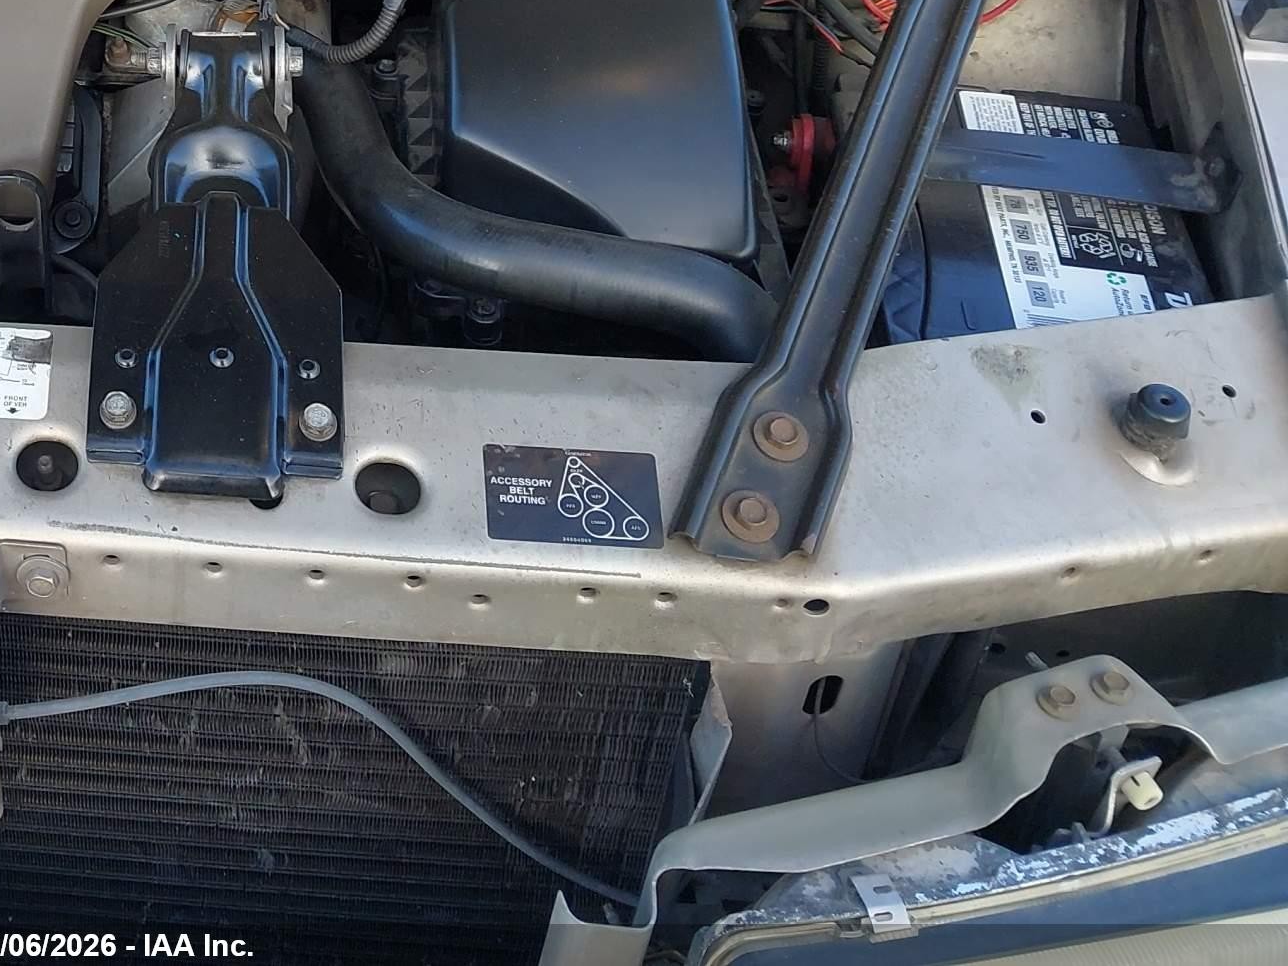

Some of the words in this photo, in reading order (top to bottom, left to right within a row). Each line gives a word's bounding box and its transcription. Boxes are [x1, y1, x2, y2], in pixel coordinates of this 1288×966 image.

[1019, 103, 1030, 113] KEEP
[1021, 113, 1033, 122] OUT
[1143, 204, 1167, 235] OISON
[1015, 224, 1030, 240] 750
[1024, 255, 1038, 271] 935
[1031, 286, 1045, 302] 120
[490, 476, 553, 488] ACCESSORY
[509, 486, 535, 495] BELT
[499, 495, 546, 505] ROUTING
